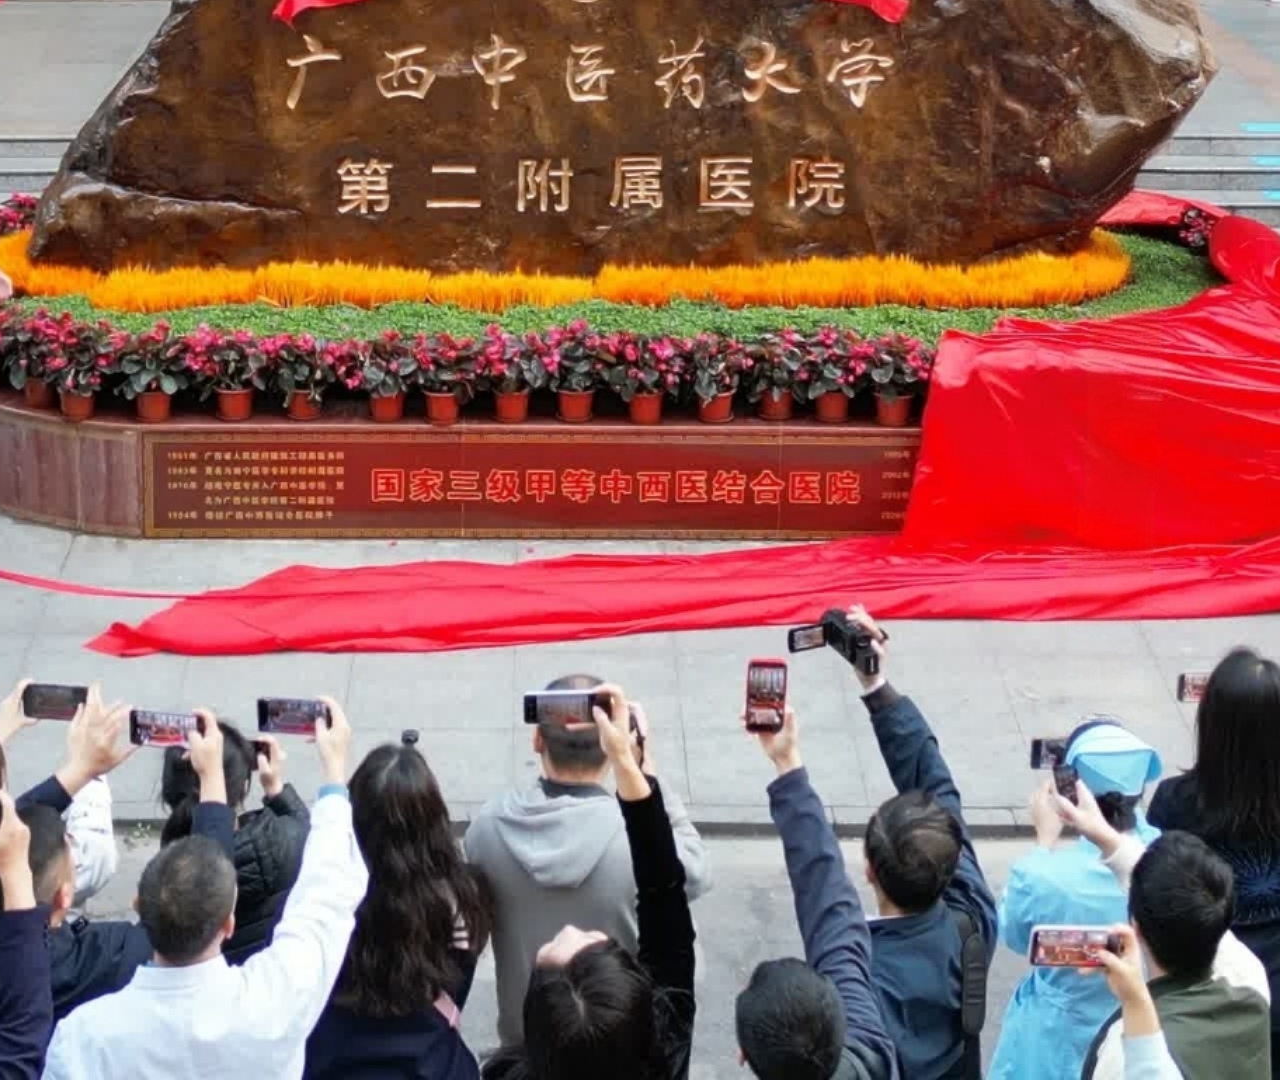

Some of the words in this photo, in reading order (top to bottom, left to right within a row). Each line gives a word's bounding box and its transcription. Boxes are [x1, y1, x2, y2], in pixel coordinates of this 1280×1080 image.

[285, 33, 897, 111] 广西中医药大学
[336, 155, 848, 215] 第二附属医院
[371, 466, 862, 505] 国家三级甲等中西医结合医院
